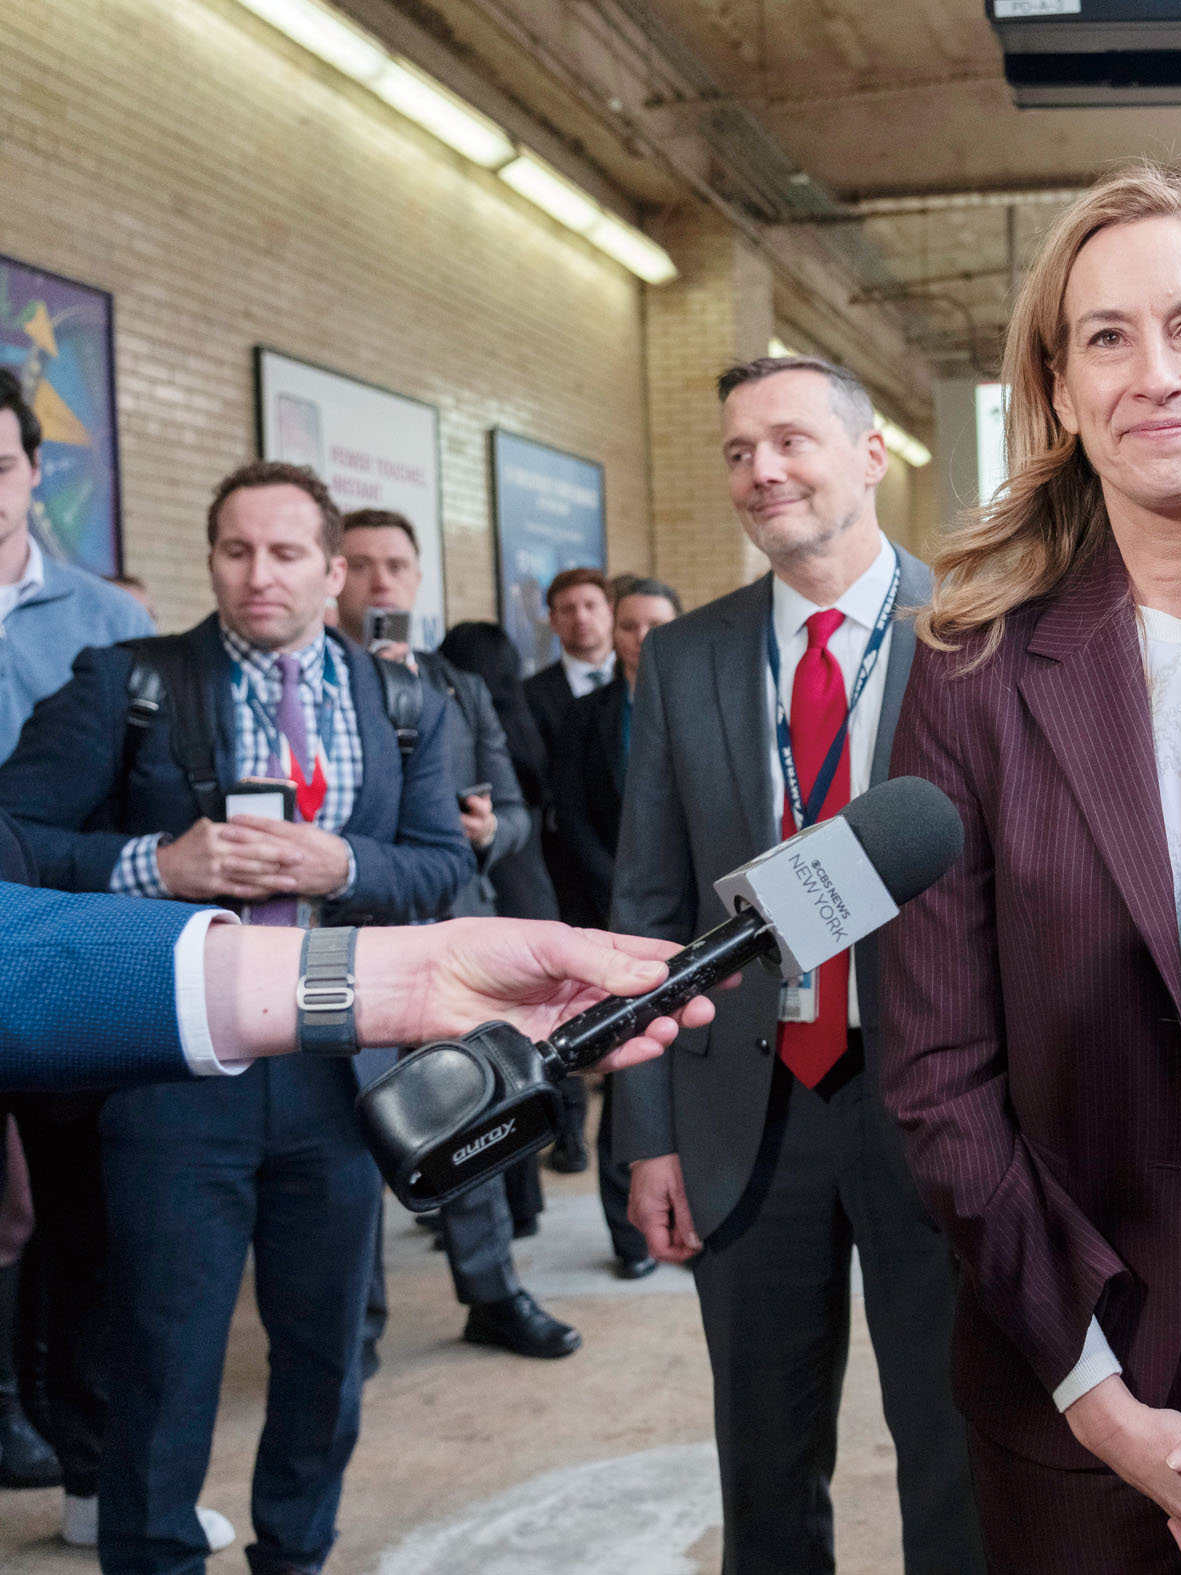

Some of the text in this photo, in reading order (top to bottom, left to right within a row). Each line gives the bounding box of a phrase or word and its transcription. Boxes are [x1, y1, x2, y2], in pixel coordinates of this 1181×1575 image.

[783, 746, 802, 810] AMTRAK
[788, 853, 848, 943] NEW YORK
[816, 868, 851, 920] CBS NEWS
